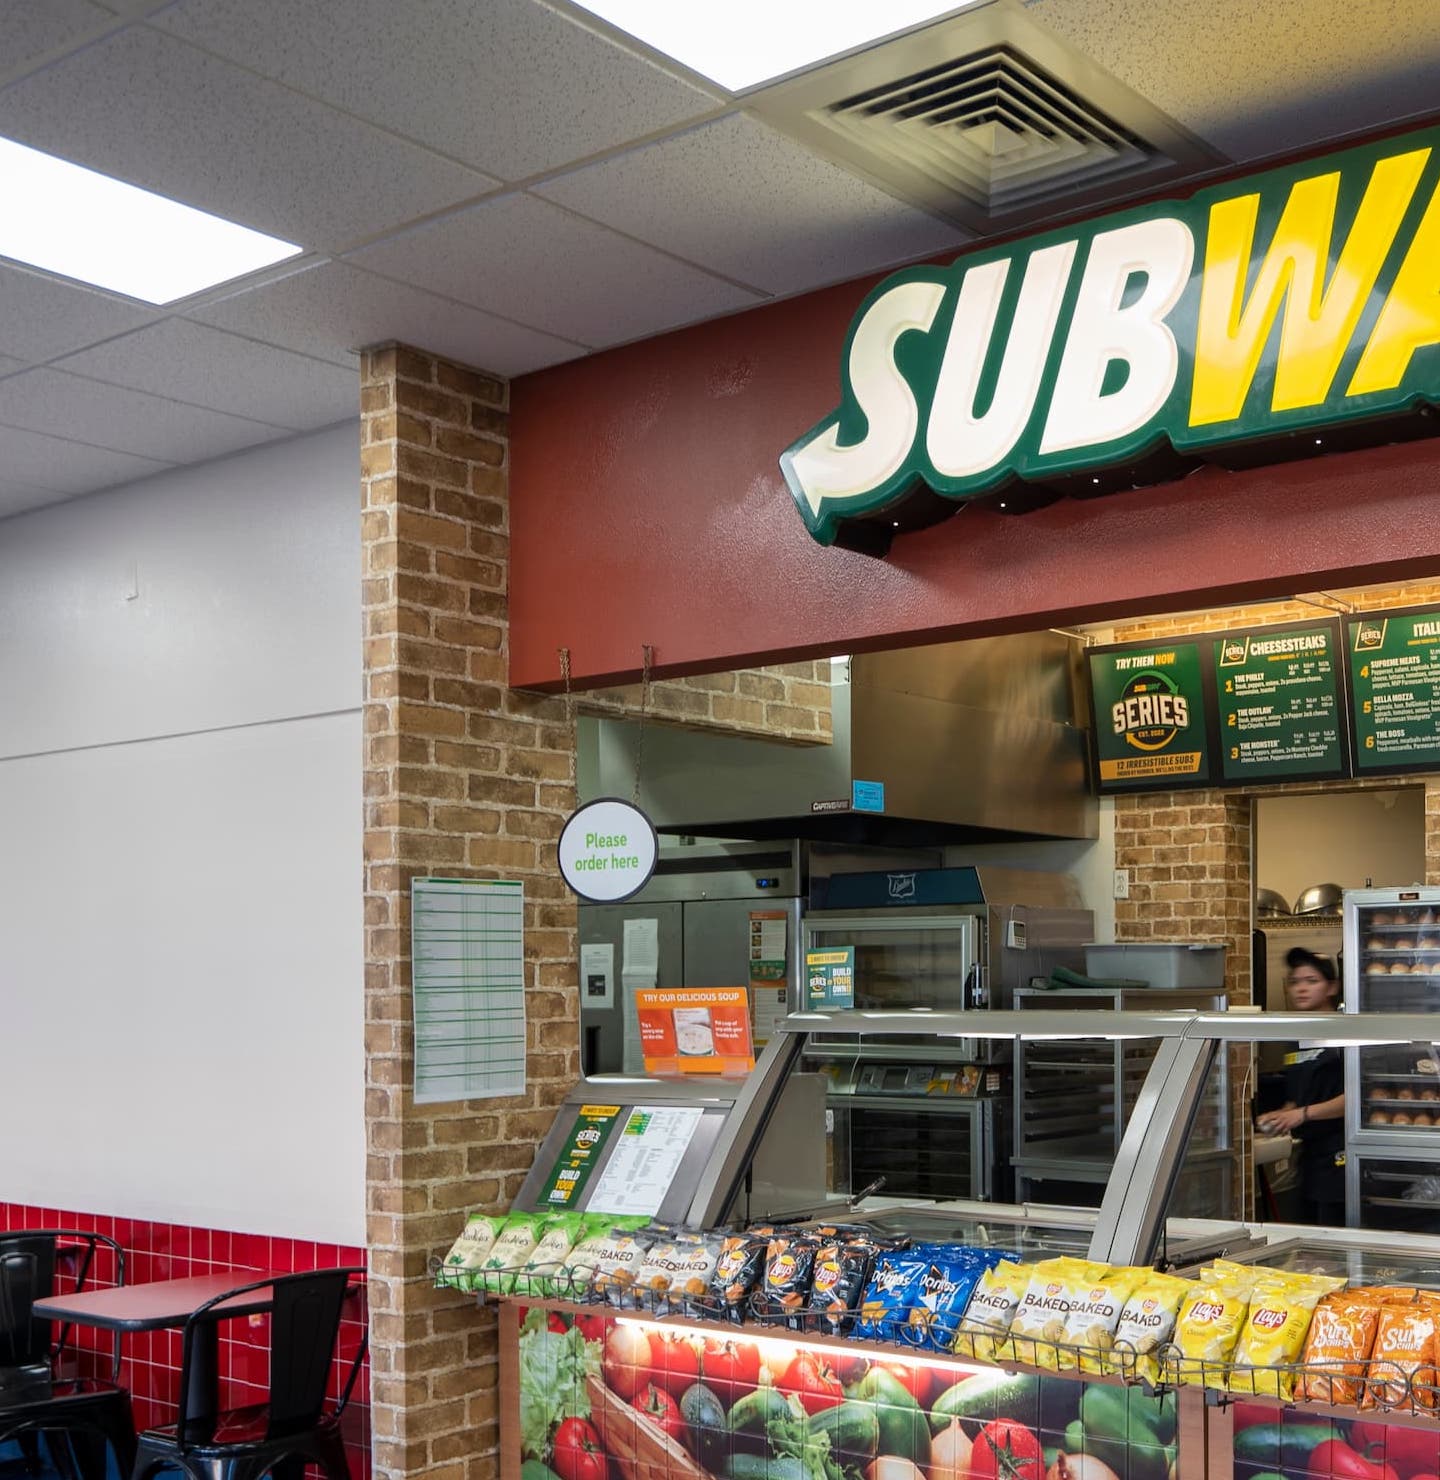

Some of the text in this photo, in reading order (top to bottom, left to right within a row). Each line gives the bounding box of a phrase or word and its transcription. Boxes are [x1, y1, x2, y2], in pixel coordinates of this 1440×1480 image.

[1250, 635, 1326, 656] CHEESESTEAKS
[1116, 652, 1176, 670] TRY THEM NOW
[1360, 666, 1369, 678] 4
[1225, 680, 1233, 692] 1
[1112, 694, 1188, 734] SERIES
[1363, 701, 1372, 713] 5
[1228, 714, 1236, 726] 2
[1365, 736, 1374, 748] 6
[1231, 748, 1239, 759] 3
[1117, 754, 1194, 770] 12 IRRESISTIBLE SUBS
[586, 833, 628, 848] Please
[575, 853, 639, 871] order here
[643, 992, 740, 1003] TRY OUR DELICIOUS SOUP
[600, 1249, 634, 1262] BAKED
[919, 1273, 956, 1294] Doritos
[1024, 1293, 1070, 1312] BAKED
[1069, 1300, 1114, 1317] BAKED
[1121, 1310, 1162, 1327] BAKED
